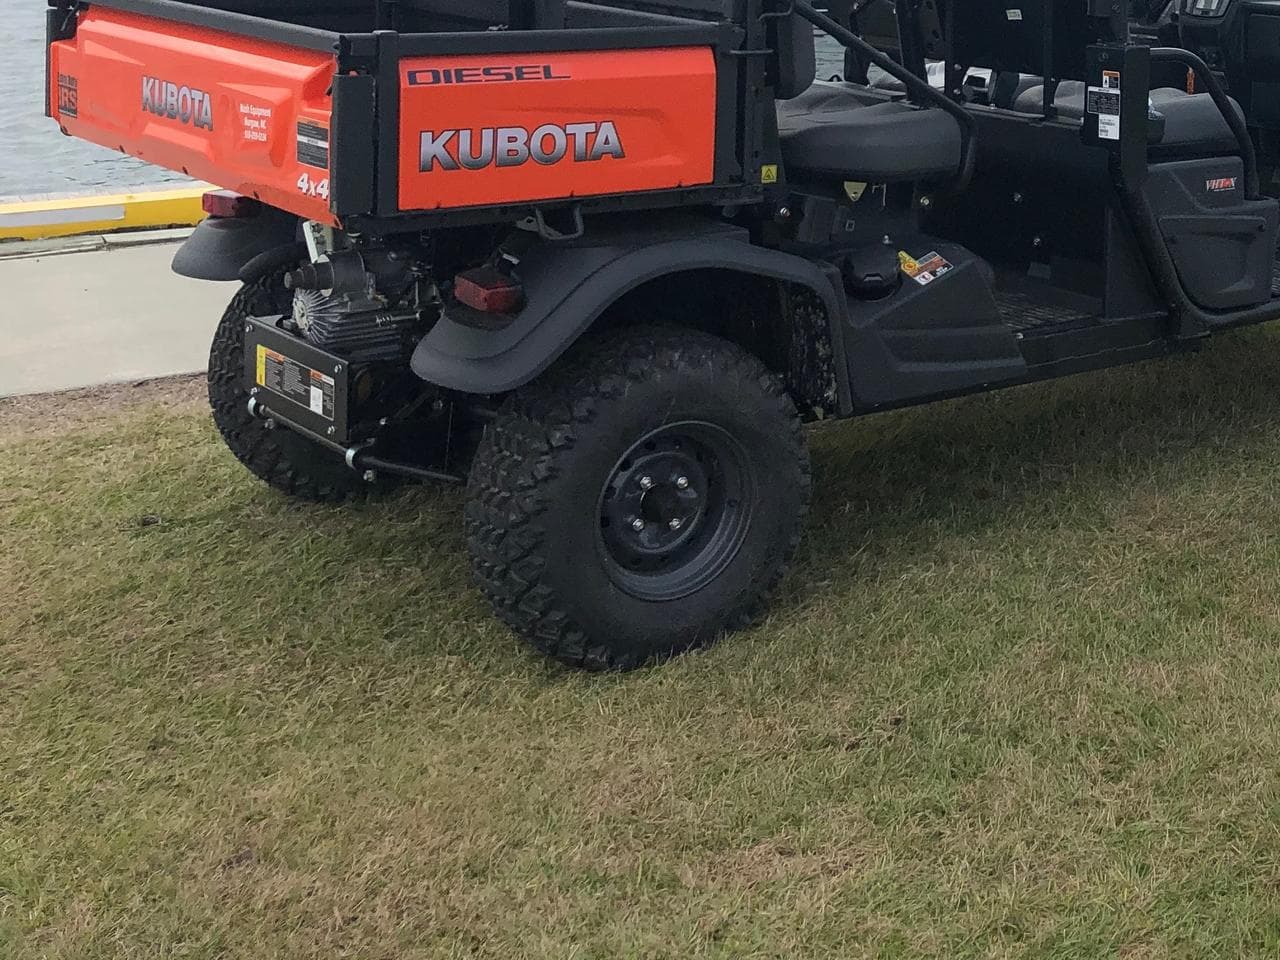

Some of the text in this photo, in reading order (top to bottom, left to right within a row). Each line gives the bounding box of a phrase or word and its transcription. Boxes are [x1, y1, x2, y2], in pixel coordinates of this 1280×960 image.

[407, 64, 572, 86] DIESEL
[142, 74, 213, 131] KUBOTA
[419, 120, 625, 172] KUBOTA
[297, 172, 329, 200] 4x4
